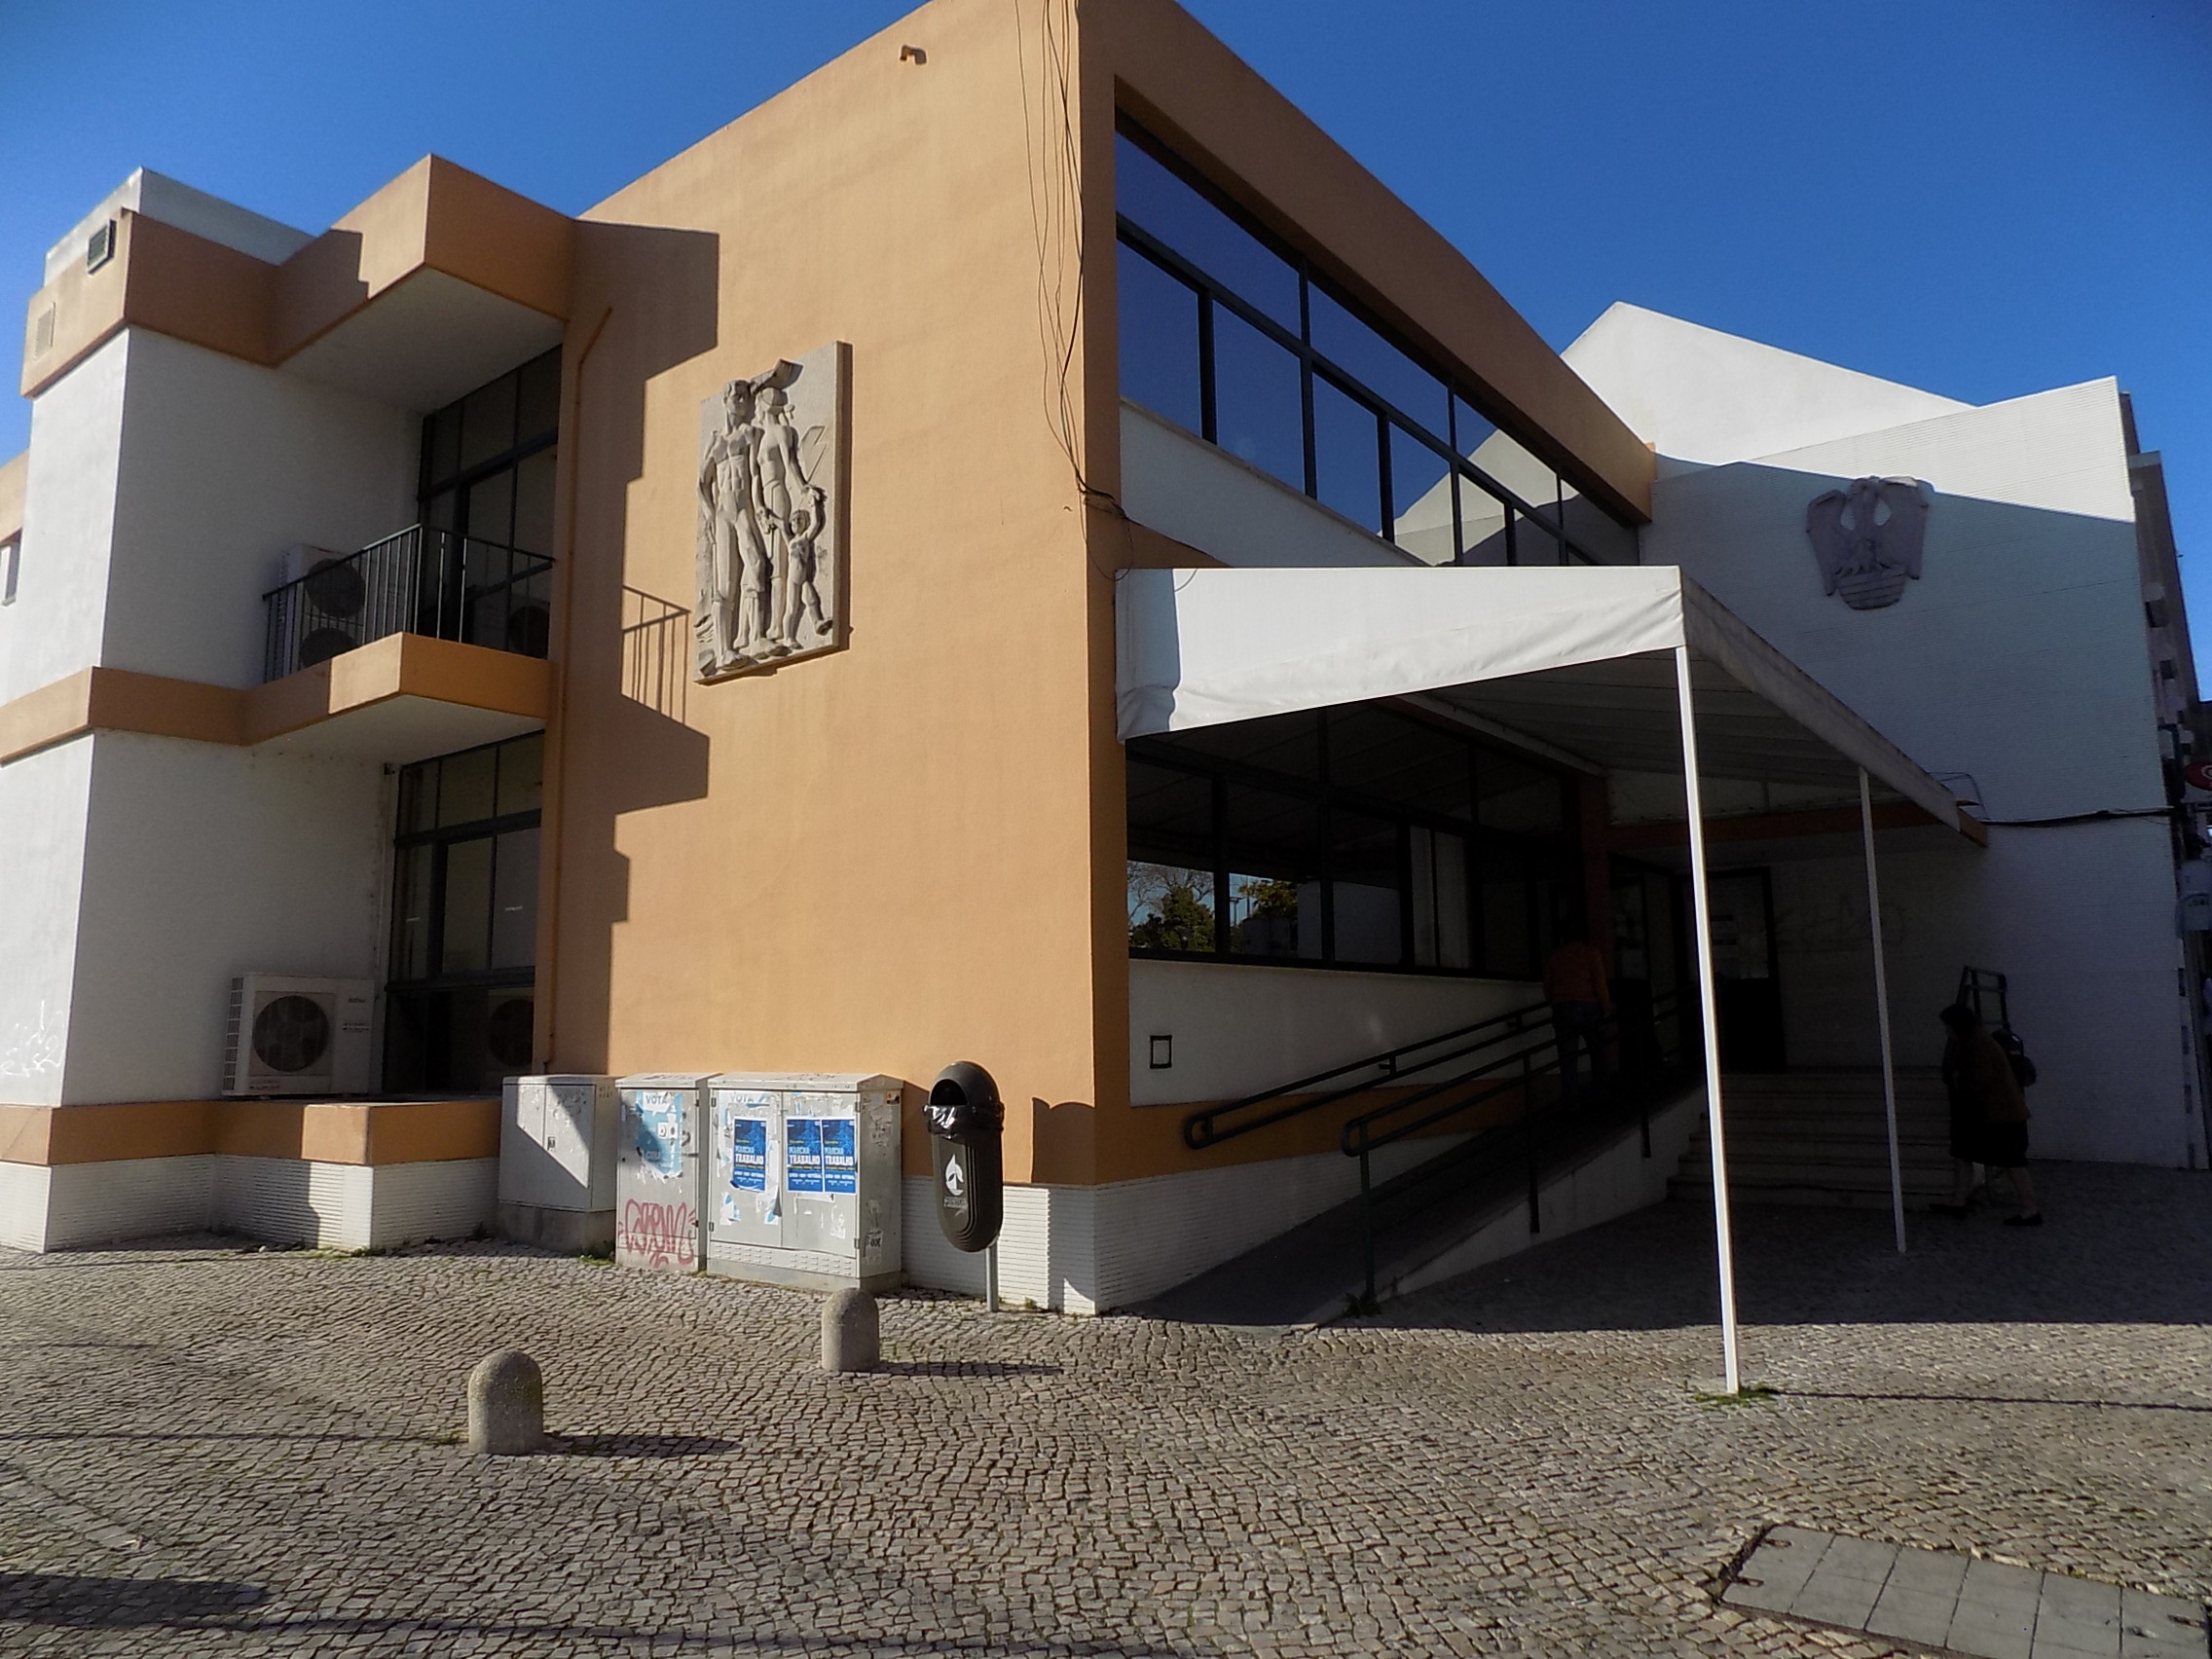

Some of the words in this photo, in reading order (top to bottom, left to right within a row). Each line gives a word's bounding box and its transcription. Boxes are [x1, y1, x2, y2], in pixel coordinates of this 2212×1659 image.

[645, 1095, 667, 1104] VOTA
[735, 1154, 764, 1164] TRABALHO
[790, 1155, 820, 1165] TRABALHO
[825, 1155, 854, 1165] TRABALHO
